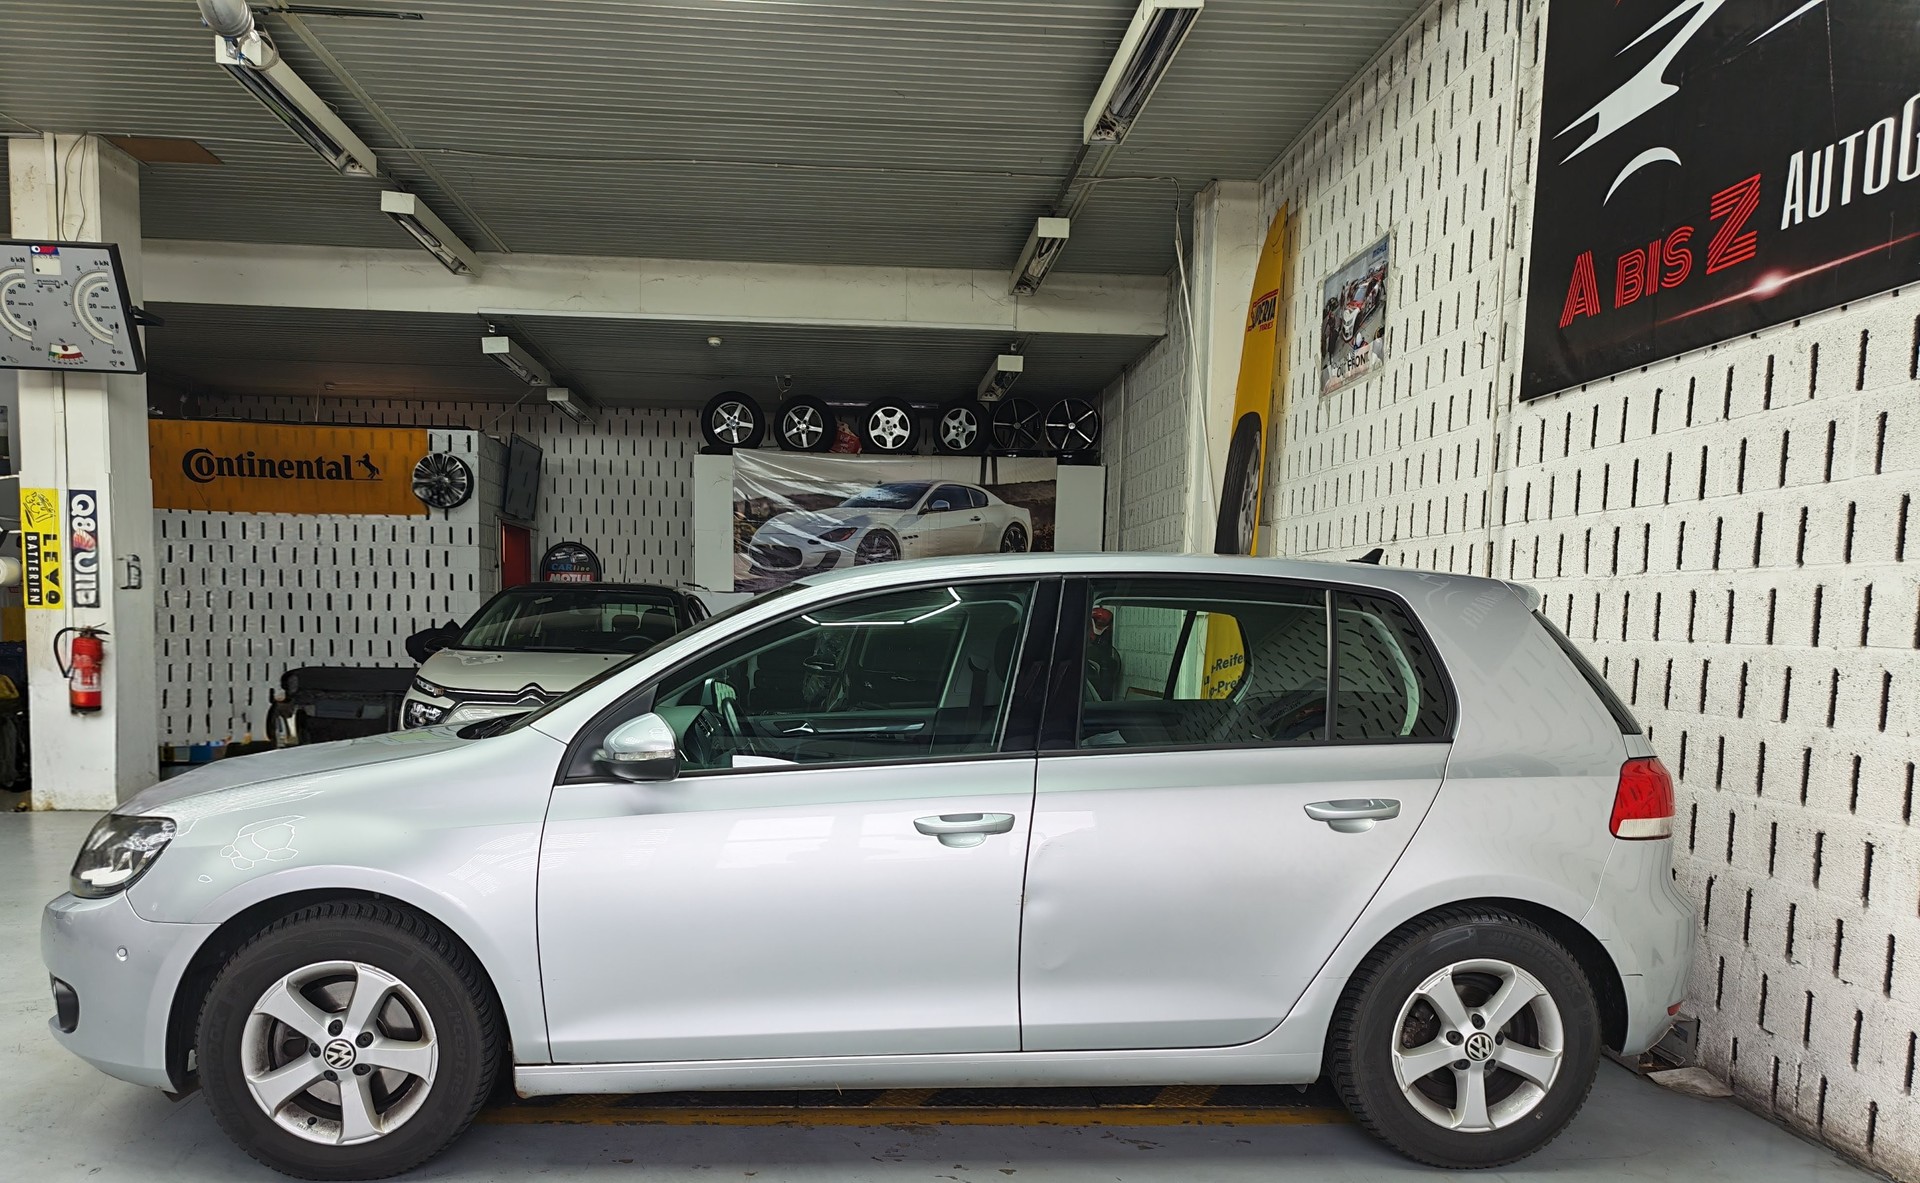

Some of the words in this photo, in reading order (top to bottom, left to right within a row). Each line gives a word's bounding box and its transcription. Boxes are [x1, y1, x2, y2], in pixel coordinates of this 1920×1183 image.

[1559, 250, 1600, 328] A
[1615, 226, 1694, 309] BIS
[1706, 173, 1761, 275] Z
[182, 447, 354, 483] Continental
[27, 535, 40, 603] BATTERIEN
[43, 534, 61, 605] LEVO
